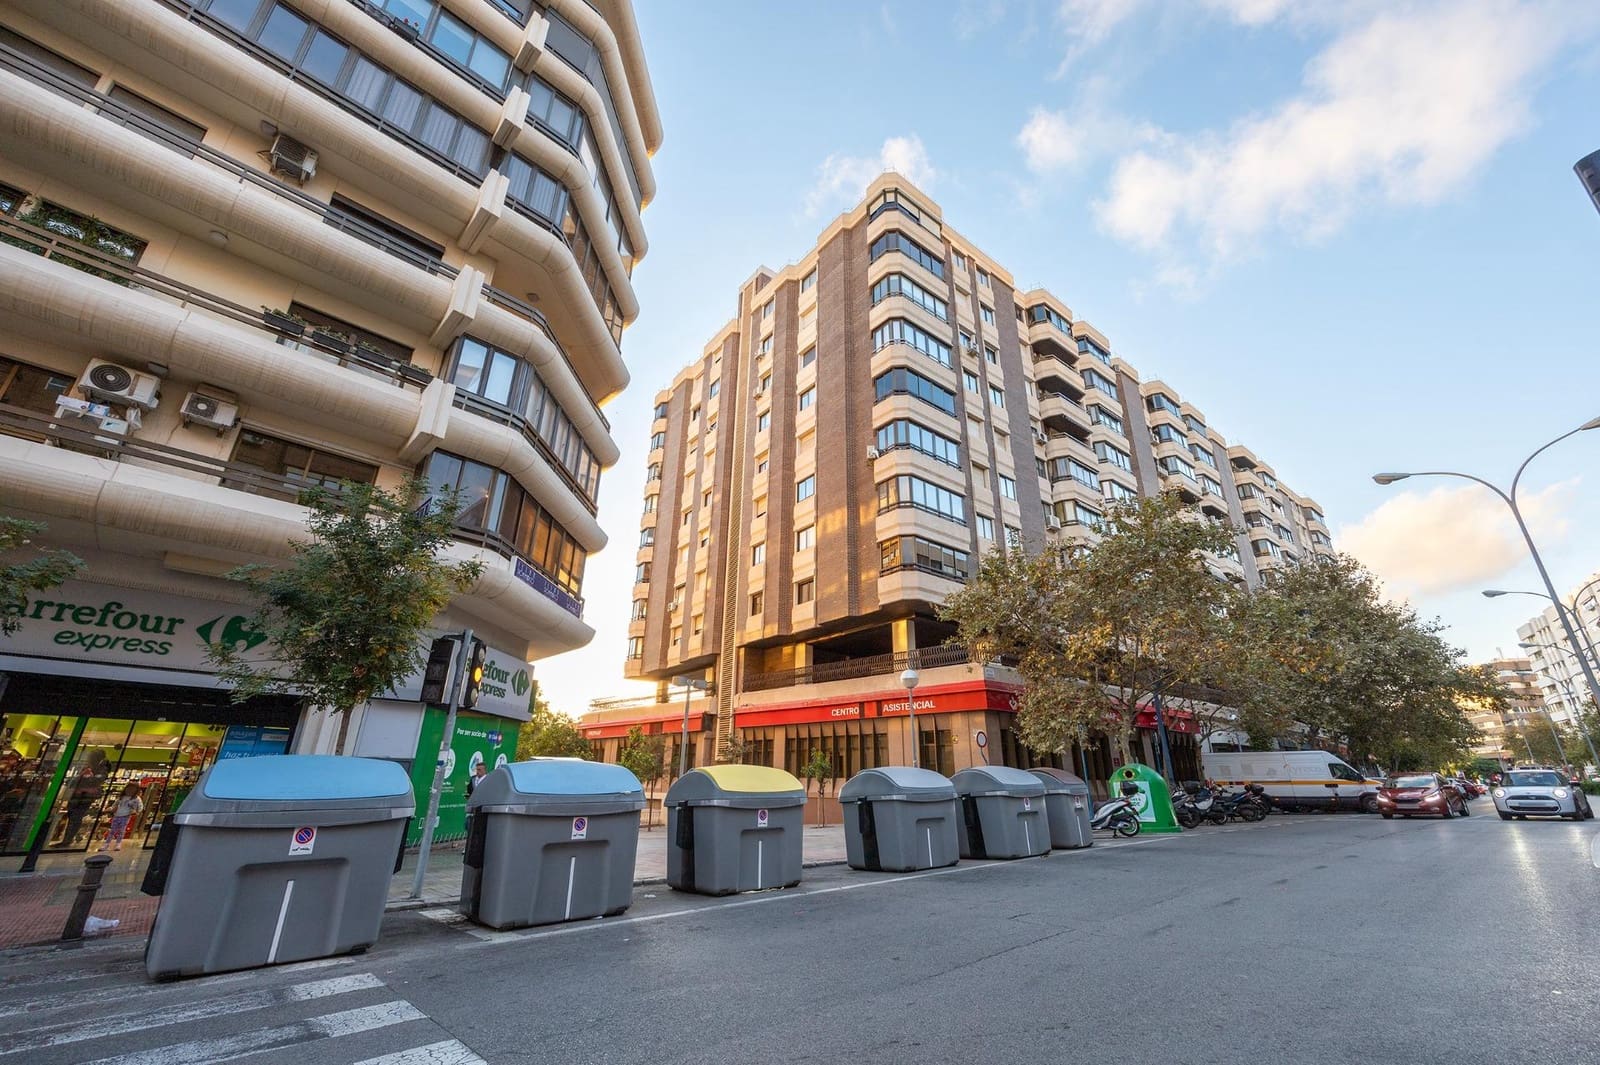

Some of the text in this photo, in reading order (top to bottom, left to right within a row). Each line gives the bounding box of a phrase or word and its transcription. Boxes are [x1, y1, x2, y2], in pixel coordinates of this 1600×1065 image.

[5, 600, 185, 635] arrefour
[54, 629, 173, 656] express
[480, 682, 507, 698] xpress
[831, 700, 937, 717] CENTRO ASISTENCIAL
